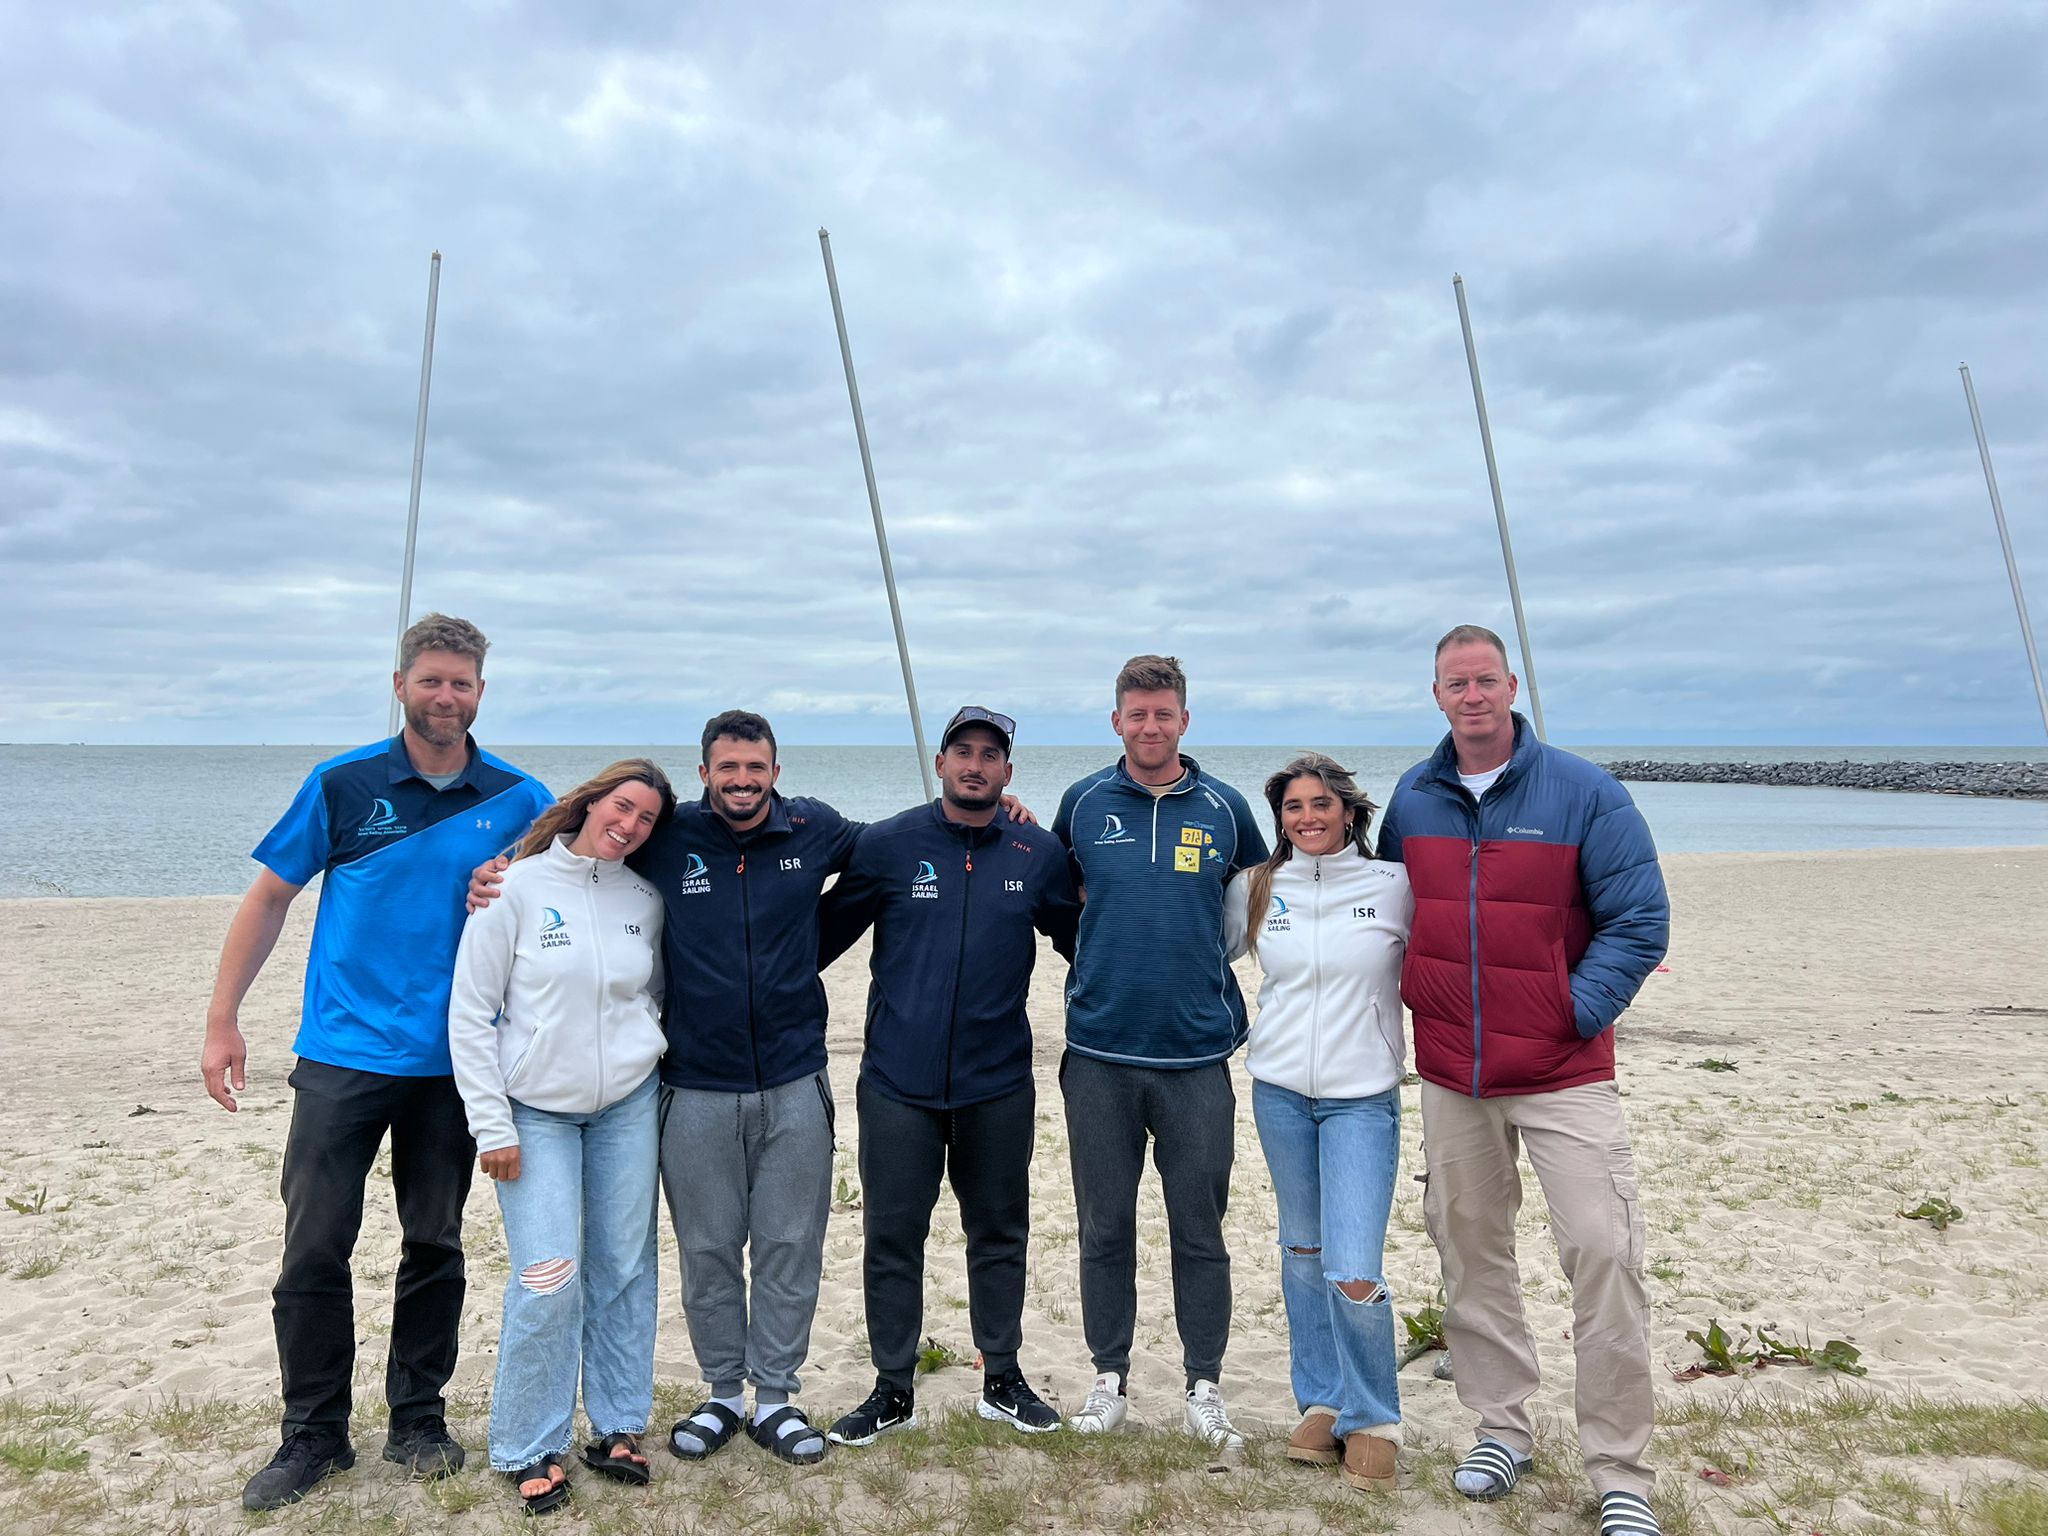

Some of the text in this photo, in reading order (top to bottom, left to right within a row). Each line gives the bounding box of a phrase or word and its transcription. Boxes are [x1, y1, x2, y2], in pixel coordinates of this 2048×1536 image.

[1513, 826, 1544, 836] Columbia
[779, 857, 802, 871] ISR
[682, 878, 710, 888] ISRAEL
[911, 884, 939, 892] ISRAEL
[1004, 879, 1024, 892] ISR
[681, 885, 711, 895] SAILING
[911, 891, 939, 899] SAILING
[1353, 907, 1376, 919] ISR
[1267, 918, 1291, 926] ISRAEL
[624, 923, 642, 937] ISR
[539, 932, 570, 942] ISRAEL
[540, 939, 572, 950] SAILING
